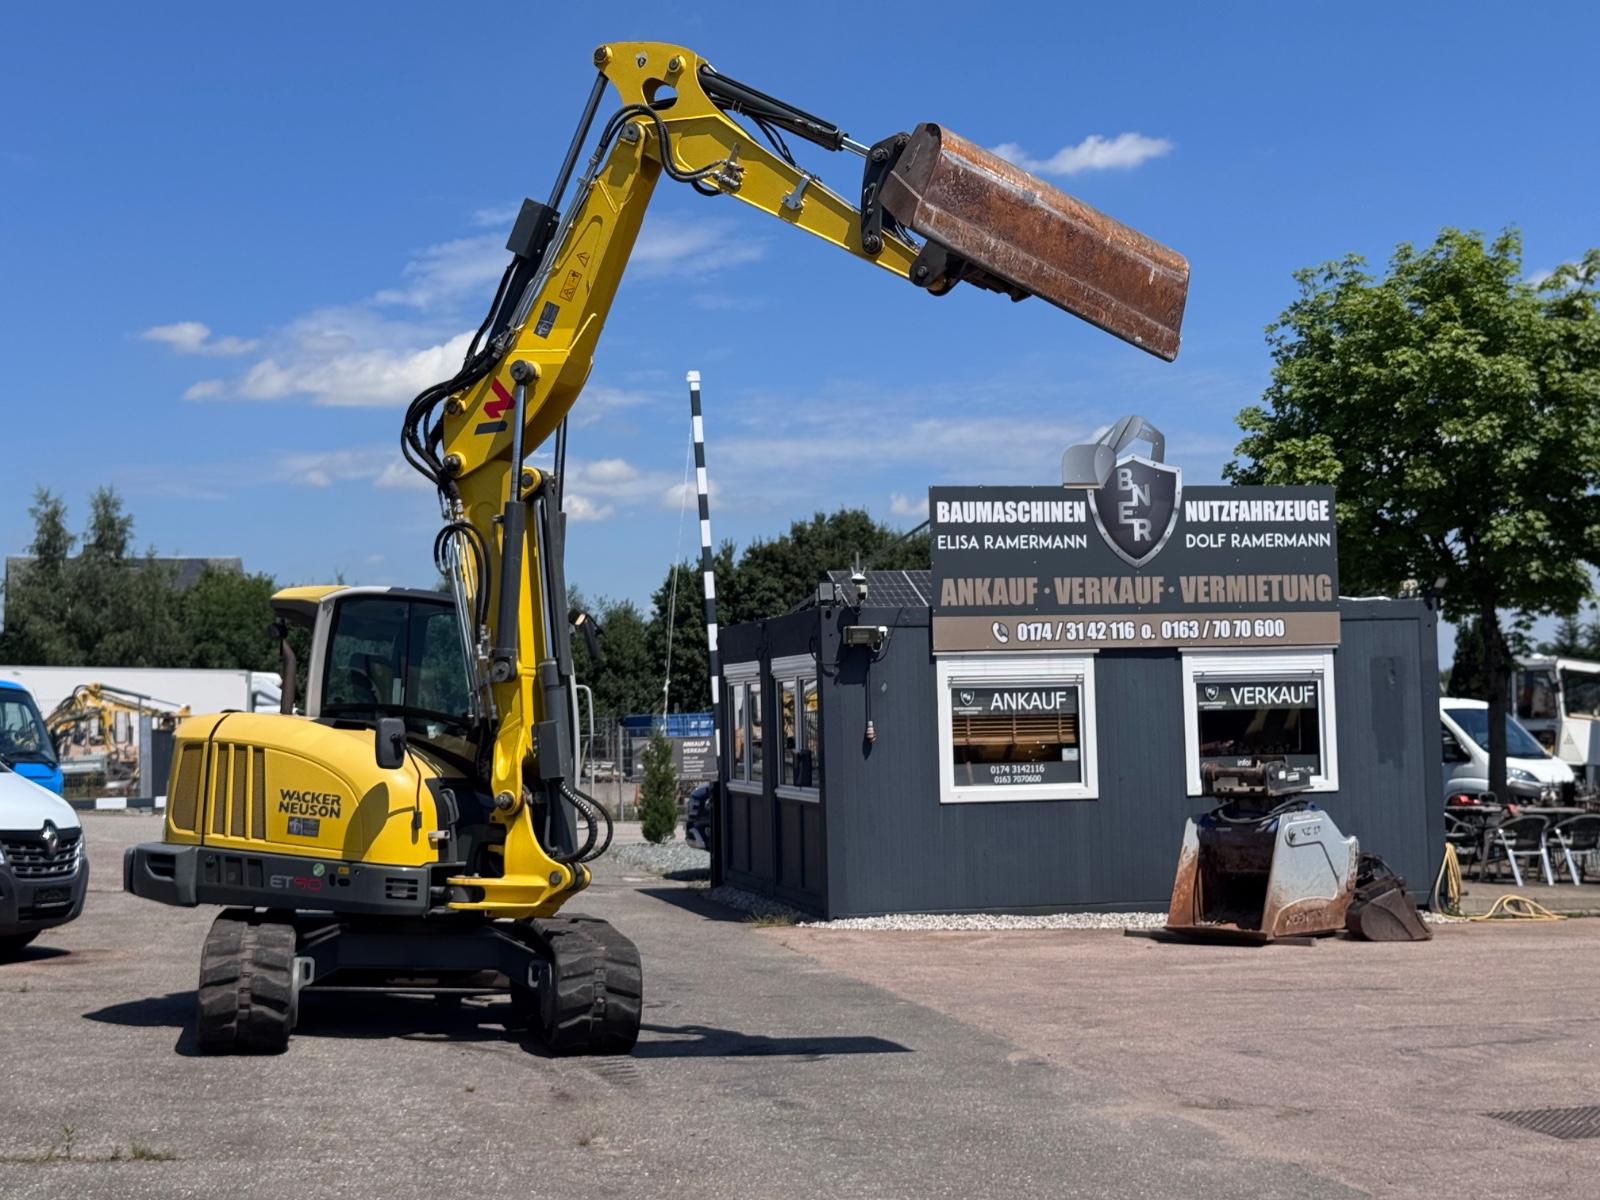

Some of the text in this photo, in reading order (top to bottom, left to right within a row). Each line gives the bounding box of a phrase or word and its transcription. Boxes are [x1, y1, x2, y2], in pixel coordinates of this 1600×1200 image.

[936, 501, 1086, 523] BAUMASCHINEN
[1185, 500, 1329, 522] NUTZFAHRZEUGE
[937, 534, 1087, 550] ELISA RAMERMANN
[1186, 533, 1331, 548] DOLF RAMERMANN
[941, 577, 1038, 606] ANKAUF
[1054, 576, 1164, 605] VERKAUF
[1179, 574, 1332, 603] VERMIETUNG
[1017, 623, 1052, 641] 0174
[1066, 622, 1085, 640] 31
[1087, 622, 1107, 640] 42
[1109, 622, 1135, 640] 116
[1161, 621, 1199, 639] 0163
[1212, 620, 1231, 639] 70
[1233, 620, 1251, 638] 70
[1254, 620, 1285, 638] 600
[991, 692, 1066, 710] ANKAUF
[1231, 686, 1314, 705] VERKAUF
[990, 764, 1045, 775] 0174 3142116
[994, 776, 1012, 784] 0163
[280, 789, 341, 806] WACKER
[279, 802, 341, 818] NEUSON
